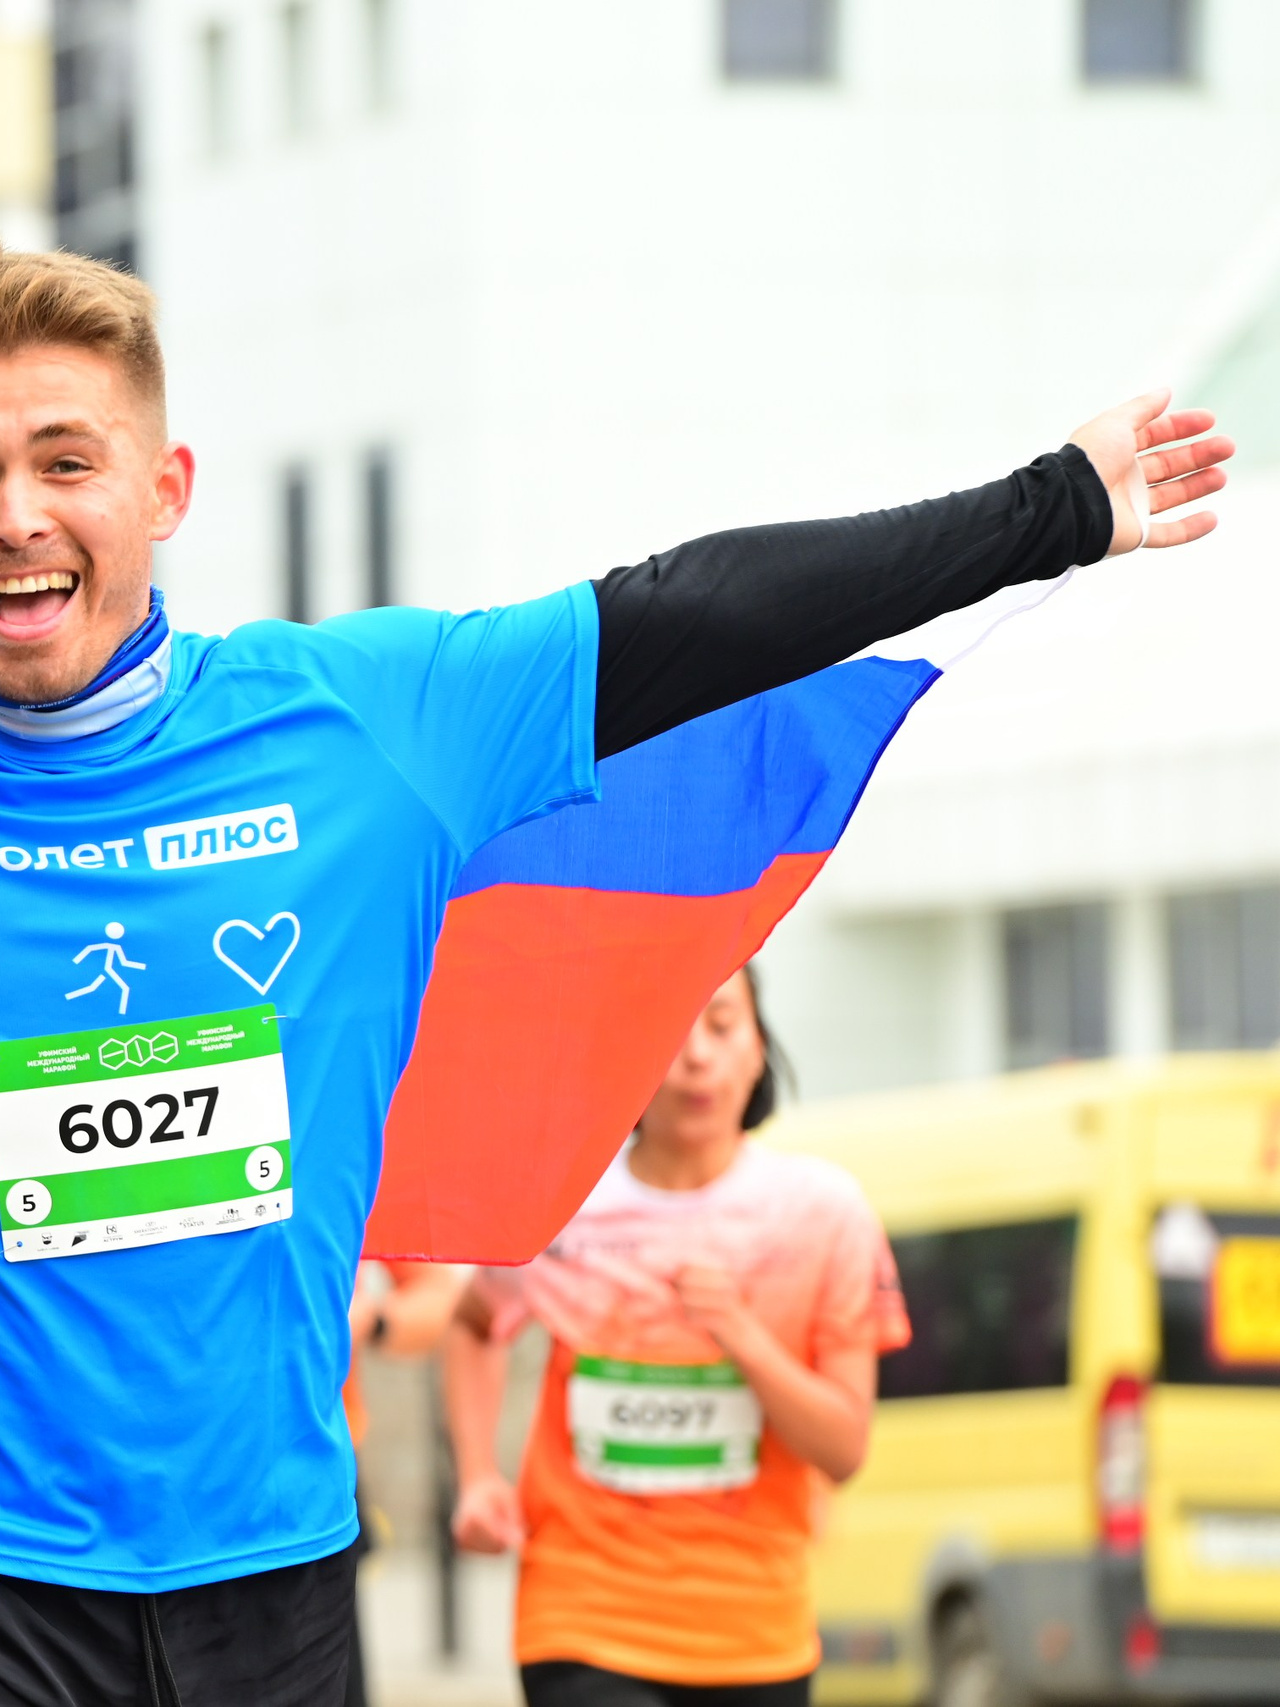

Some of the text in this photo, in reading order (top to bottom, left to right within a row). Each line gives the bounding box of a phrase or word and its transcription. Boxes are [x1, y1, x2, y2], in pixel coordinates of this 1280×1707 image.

[160, 816, 288, 863] плюс
[26, 1053, 91, 1067] МЕЖДУНАРОДНЫЙ
[38, 1046, 77, 1058] УФИМСКИЙ
[43, 1064, 77, 1074] МАРАФОН
[58, 1086, 219, 1154] 6027
[259, 1160, 270, 1178] 5
[22, 1194, 36, 1212] 5
